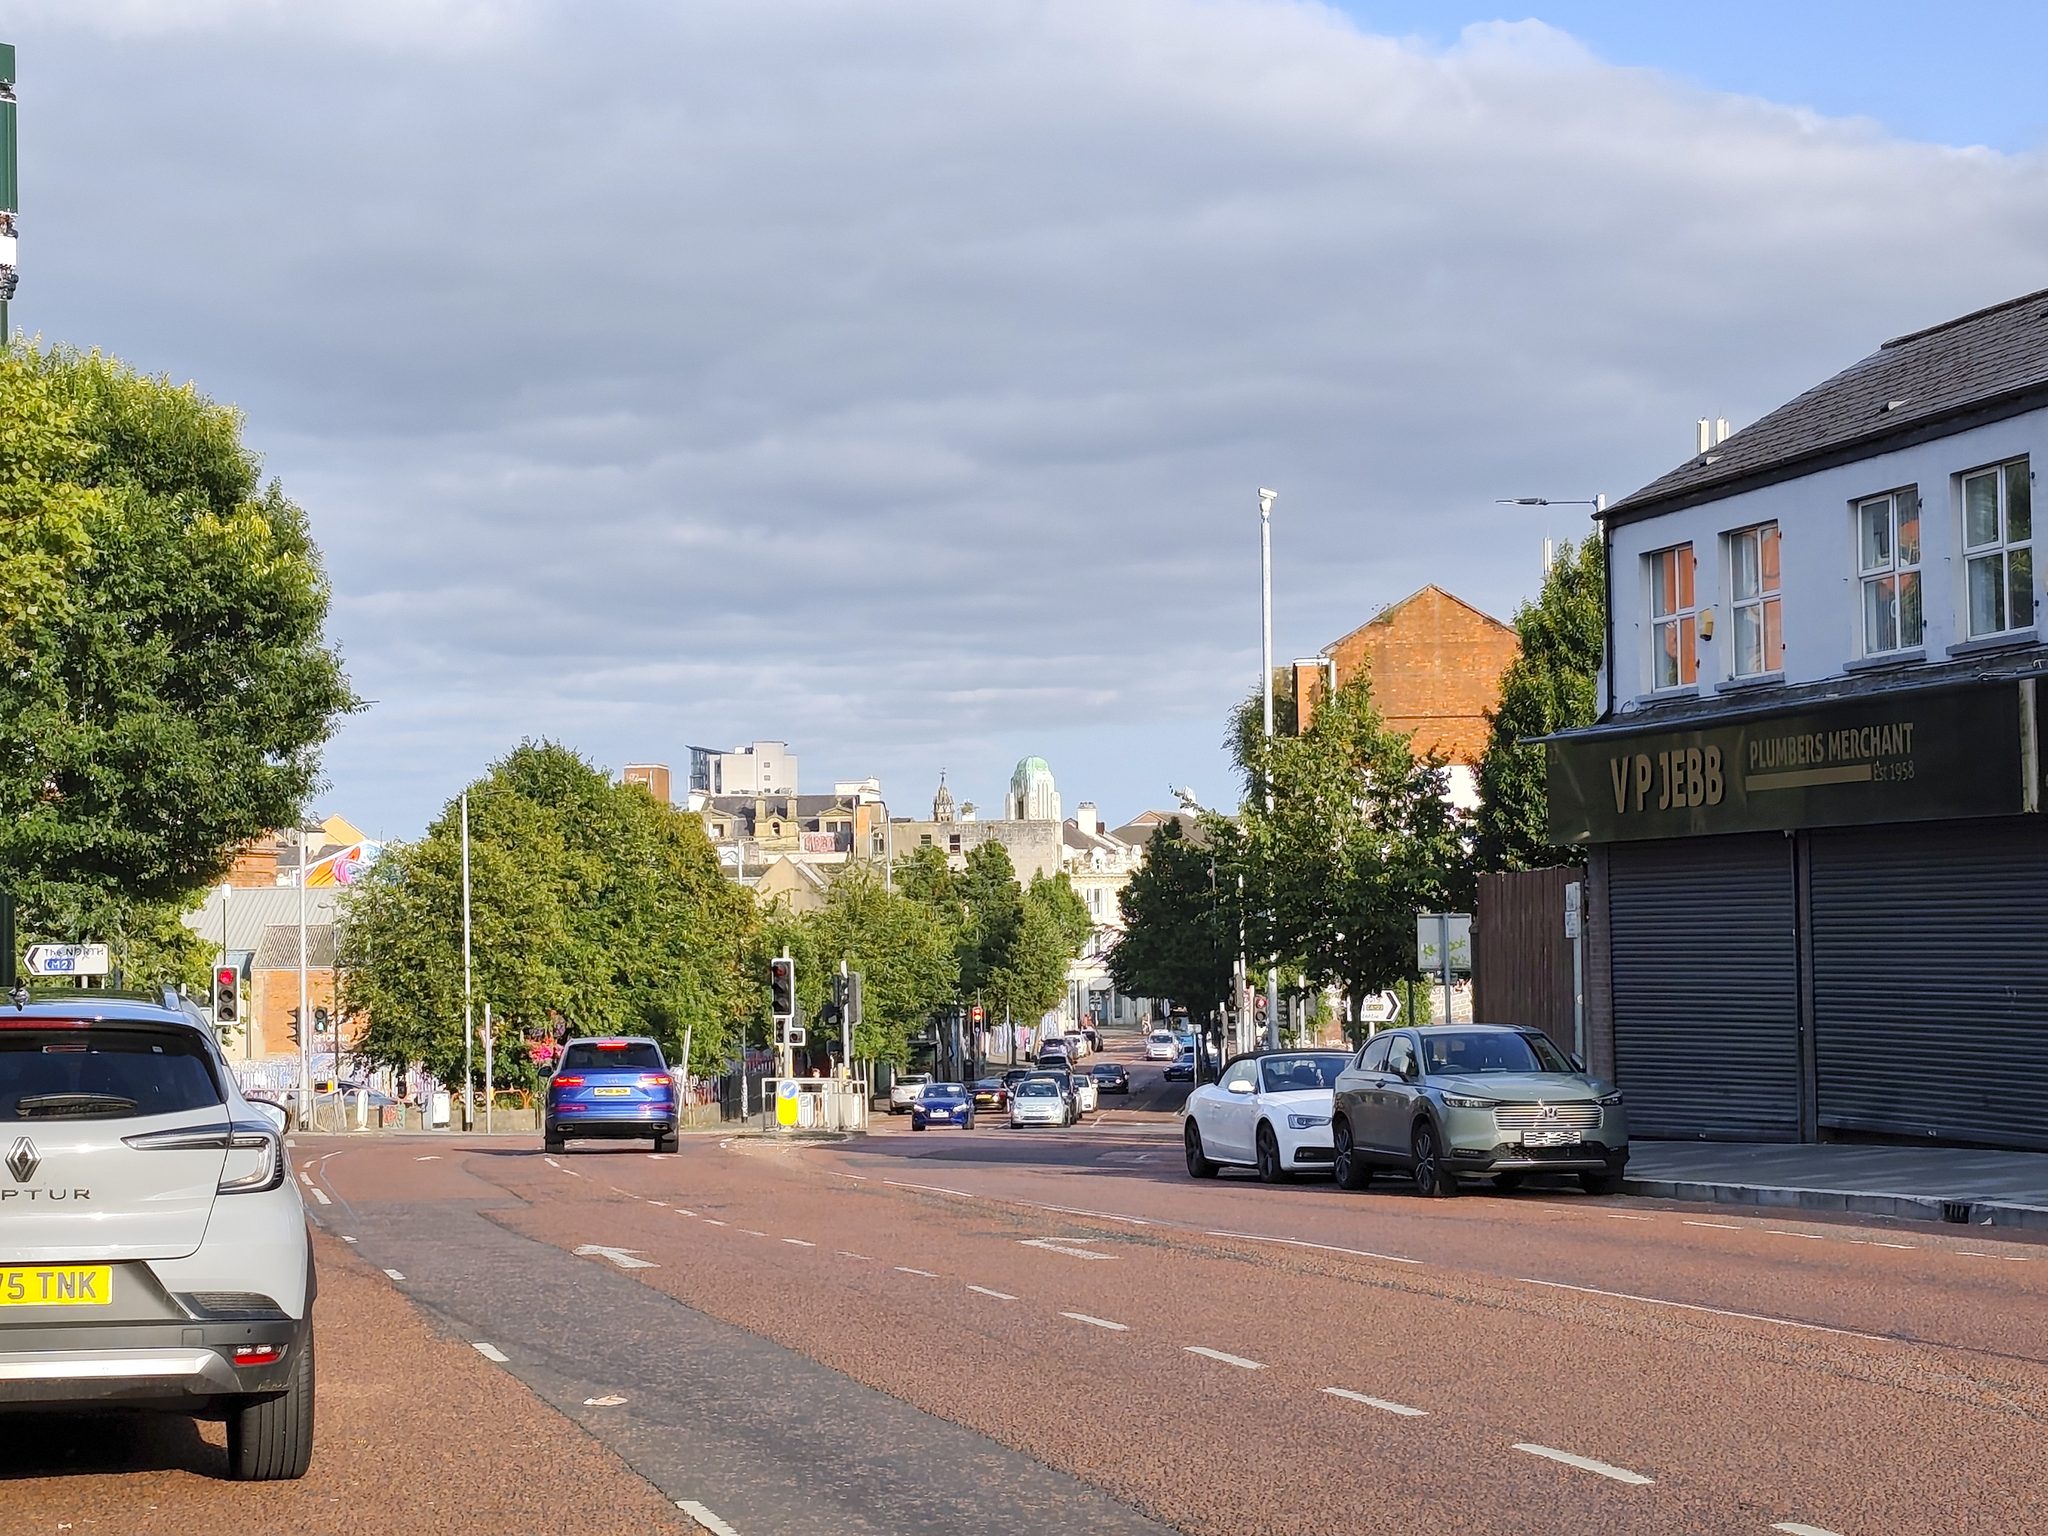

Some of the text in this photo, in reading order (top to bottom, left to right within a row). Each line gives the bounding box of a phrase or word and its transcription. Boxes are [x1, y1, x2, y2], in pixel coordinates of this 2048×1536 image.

[1750, 722, 1913, 769] PLUMBERS MERCHANT
[1610, 745, 1723, 814] V P JEBB
[1890, 760, 1915, 782] 1958
[44, 946, 104, 957] The NORTH
[0, 1271, 97, 1300] 5 TNK
